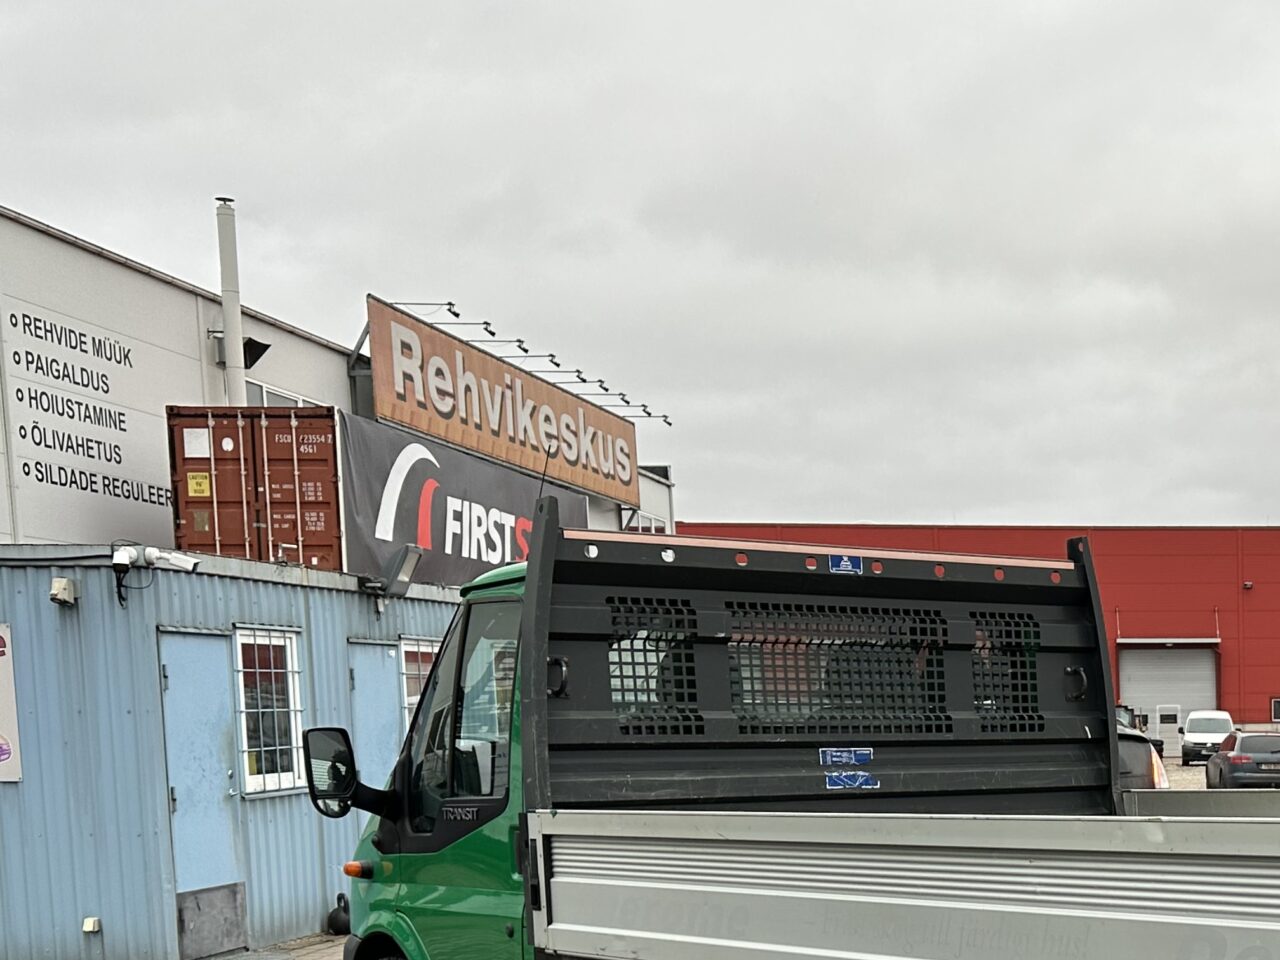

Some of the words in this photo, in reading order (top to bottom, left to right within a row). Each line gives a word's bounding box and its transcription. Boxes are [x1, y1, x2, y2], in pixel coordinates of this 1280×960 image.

[22, 313, 89, 354] REHVIDE
[92, 336, 133, 368] MÜÜK
[25, 350, 110, 394] PAIGALDUS
[28, 387, 127, 432] HOIUSTAMINE
[390, 321, 633, 483] Rehvikeskus
[31, 420, 122, 465] ÕLIVAHETUS
[275, 433, 292, 443] FSCU
[35, 461, 99, 494] SILDADE
[442, 807, 478, 820] TRANSIT
